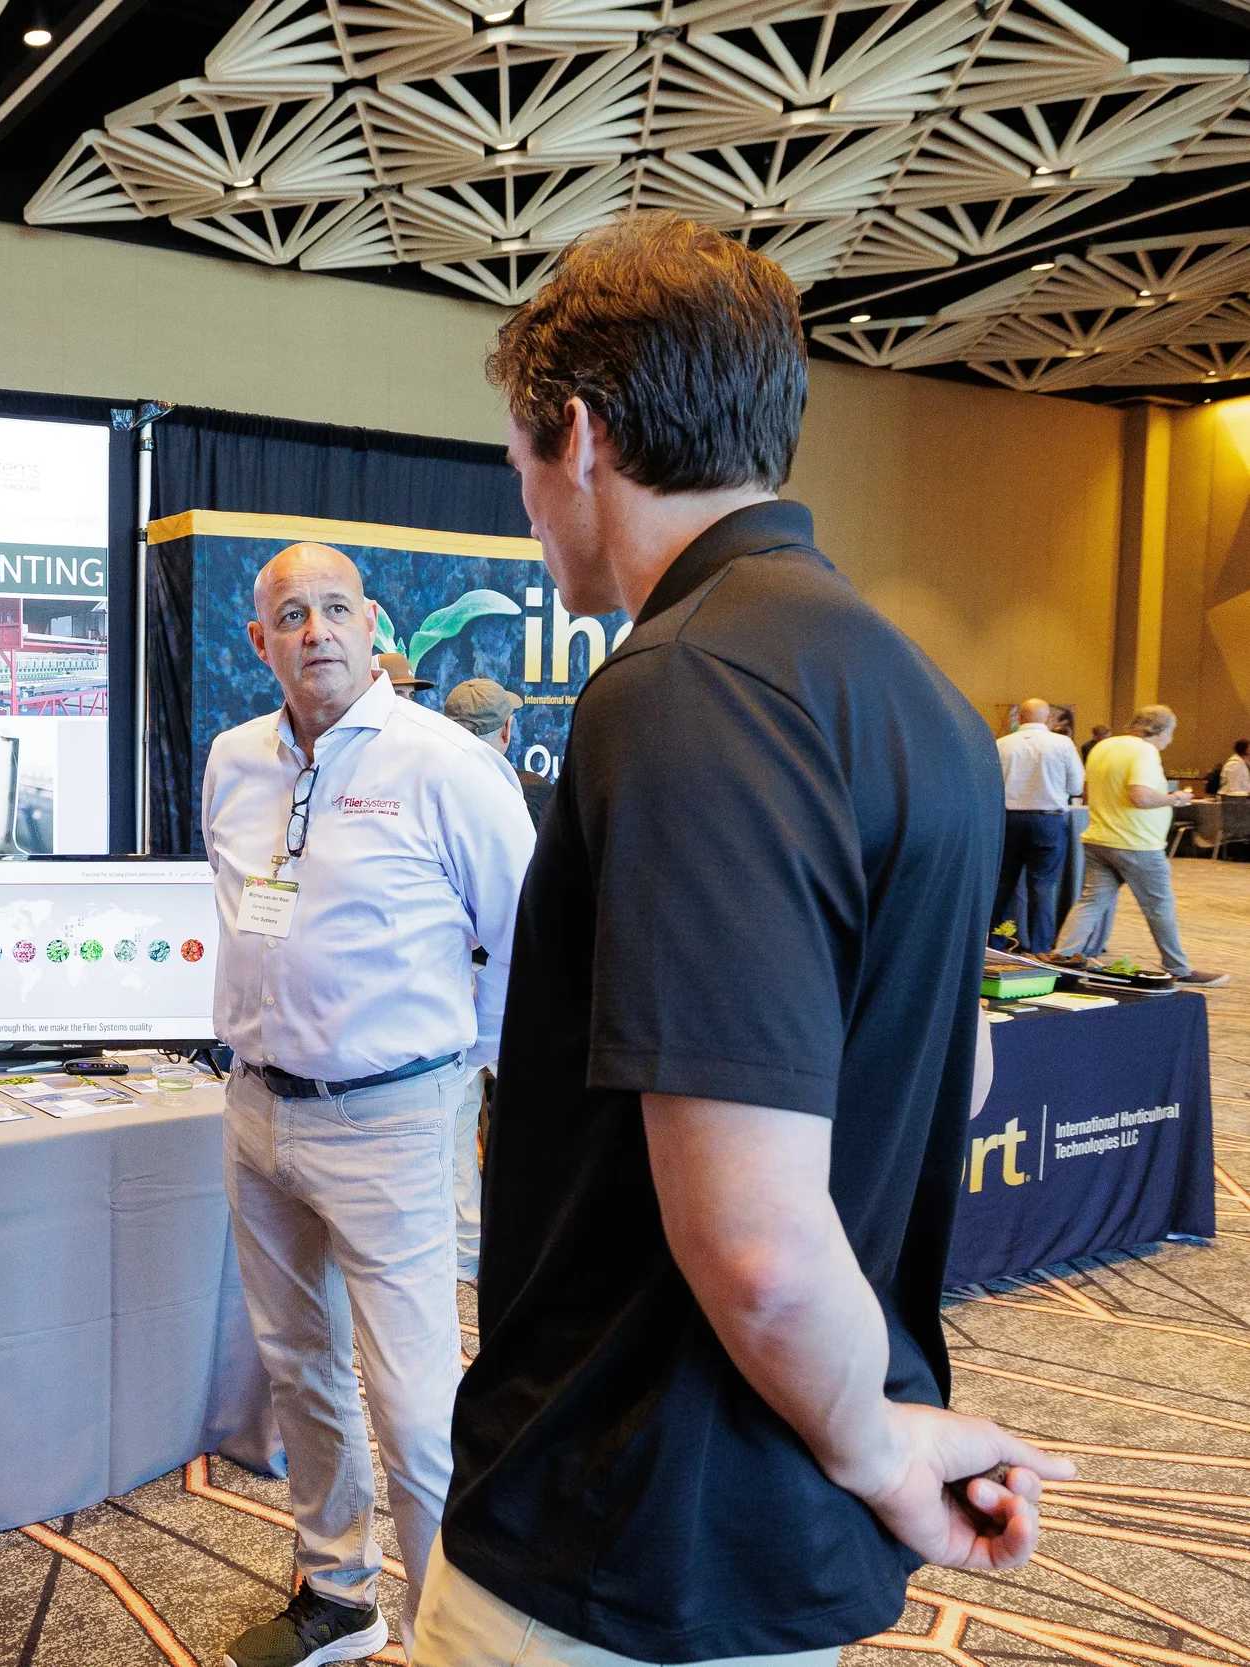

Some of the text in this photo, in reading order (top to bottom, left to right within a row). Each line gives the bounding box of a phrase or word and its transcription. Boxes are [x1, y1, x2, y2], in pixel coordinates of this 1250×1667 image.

[524, 695, 564, 705] International
[344, 798, 401, 810] Flier Systems
[22, 1023, 37, 1032] this,
[39, 1024, 49, 1032] we
[50, 1023, 69, 1032] make
[70, 1023, 82, 1032] the
[83, 1022, 98, 1032] Flier
[99, 1022, 128, 1033] Systems
[129, 1022, 153, 1033] quality
[1055, 1102, 1180, 1139] International Horticultural
[961, 1117, 1027, 1193] rt
[1054, 1129, 1139, 1160] Technologies LLC
